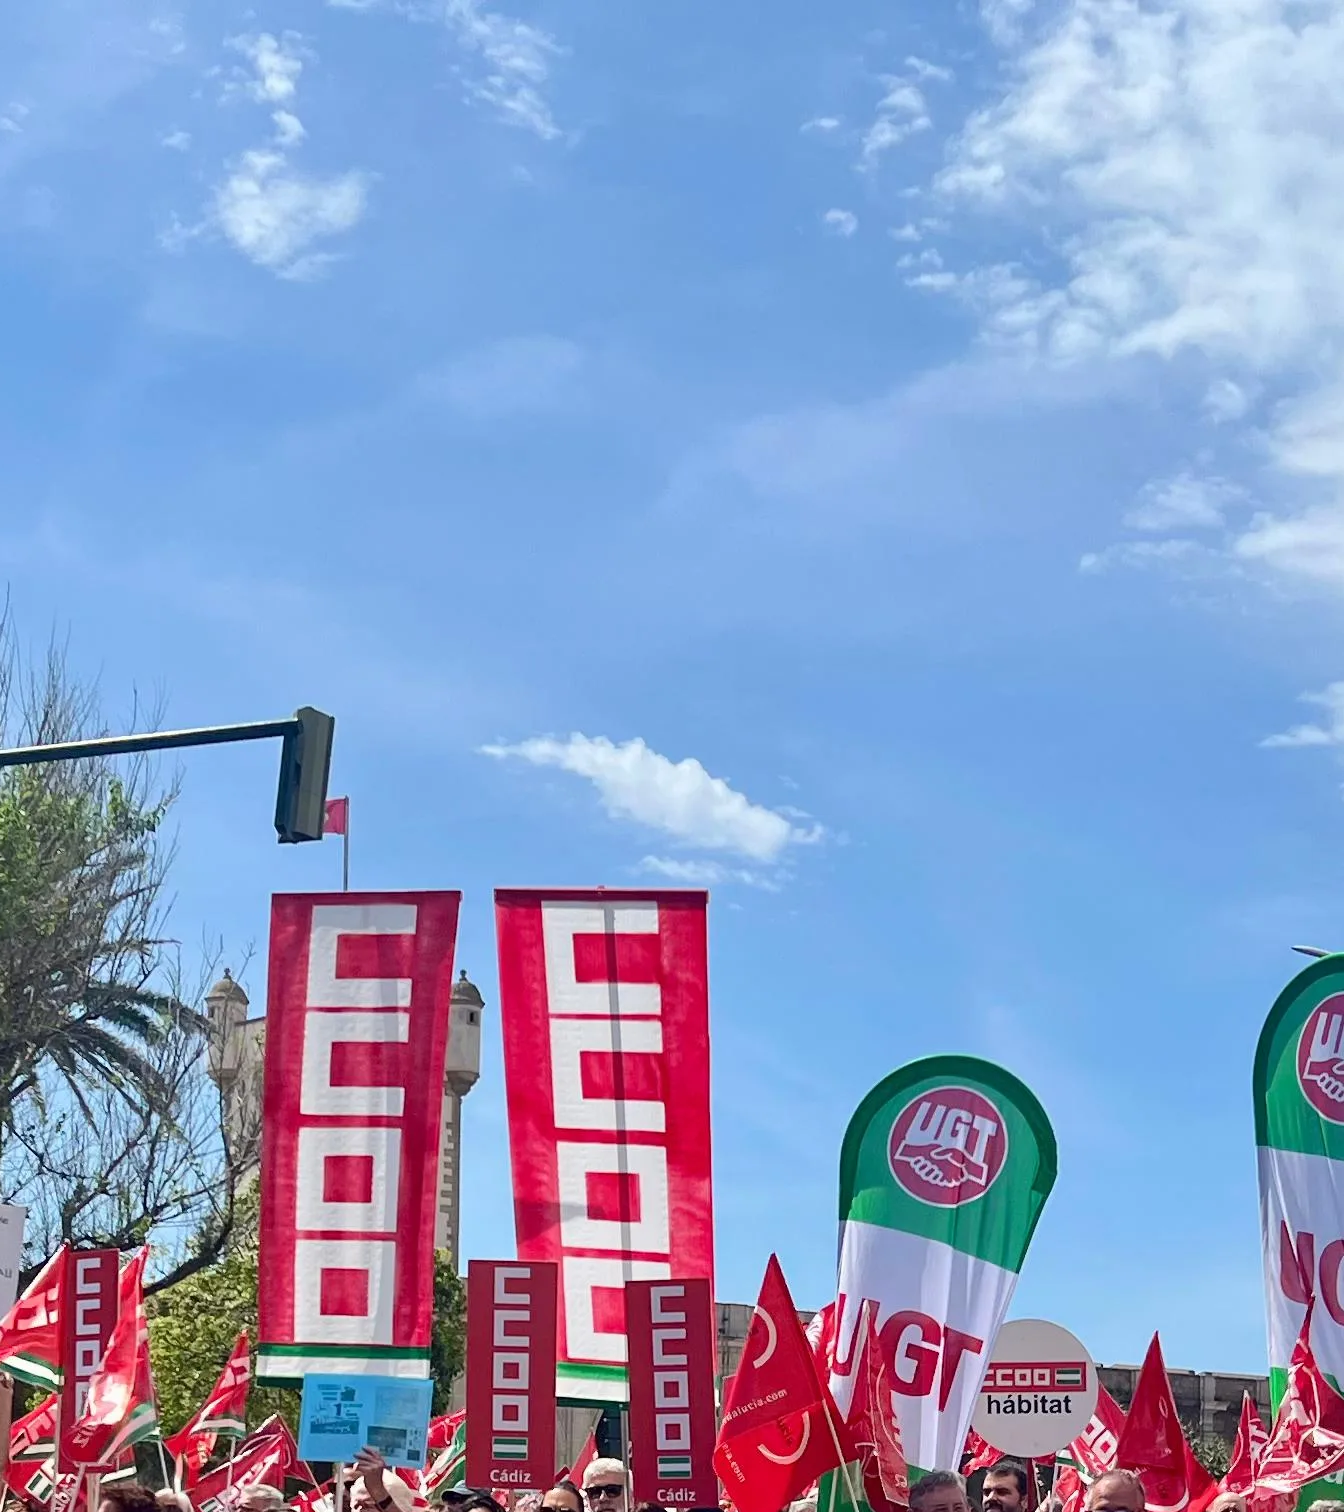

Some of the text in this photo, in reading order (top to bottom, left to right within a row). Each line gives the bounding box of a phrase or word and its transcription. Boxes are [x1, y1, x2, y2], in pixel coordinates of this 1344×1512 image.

[294, 904, 417, 1345] CCOO
[904, 1102, 997, 1163] UGT
[493, 1267, 531, 1432] CCOO
[650, 1285, 691, 1450] CCOO
[829, 1293, 983, 1413] UGT
[987, 1395, 1072, 1415] hábitat
[490, 1468, 531, 1484] Cádiz
[657, 1488, 697, 1503] Cádiz
